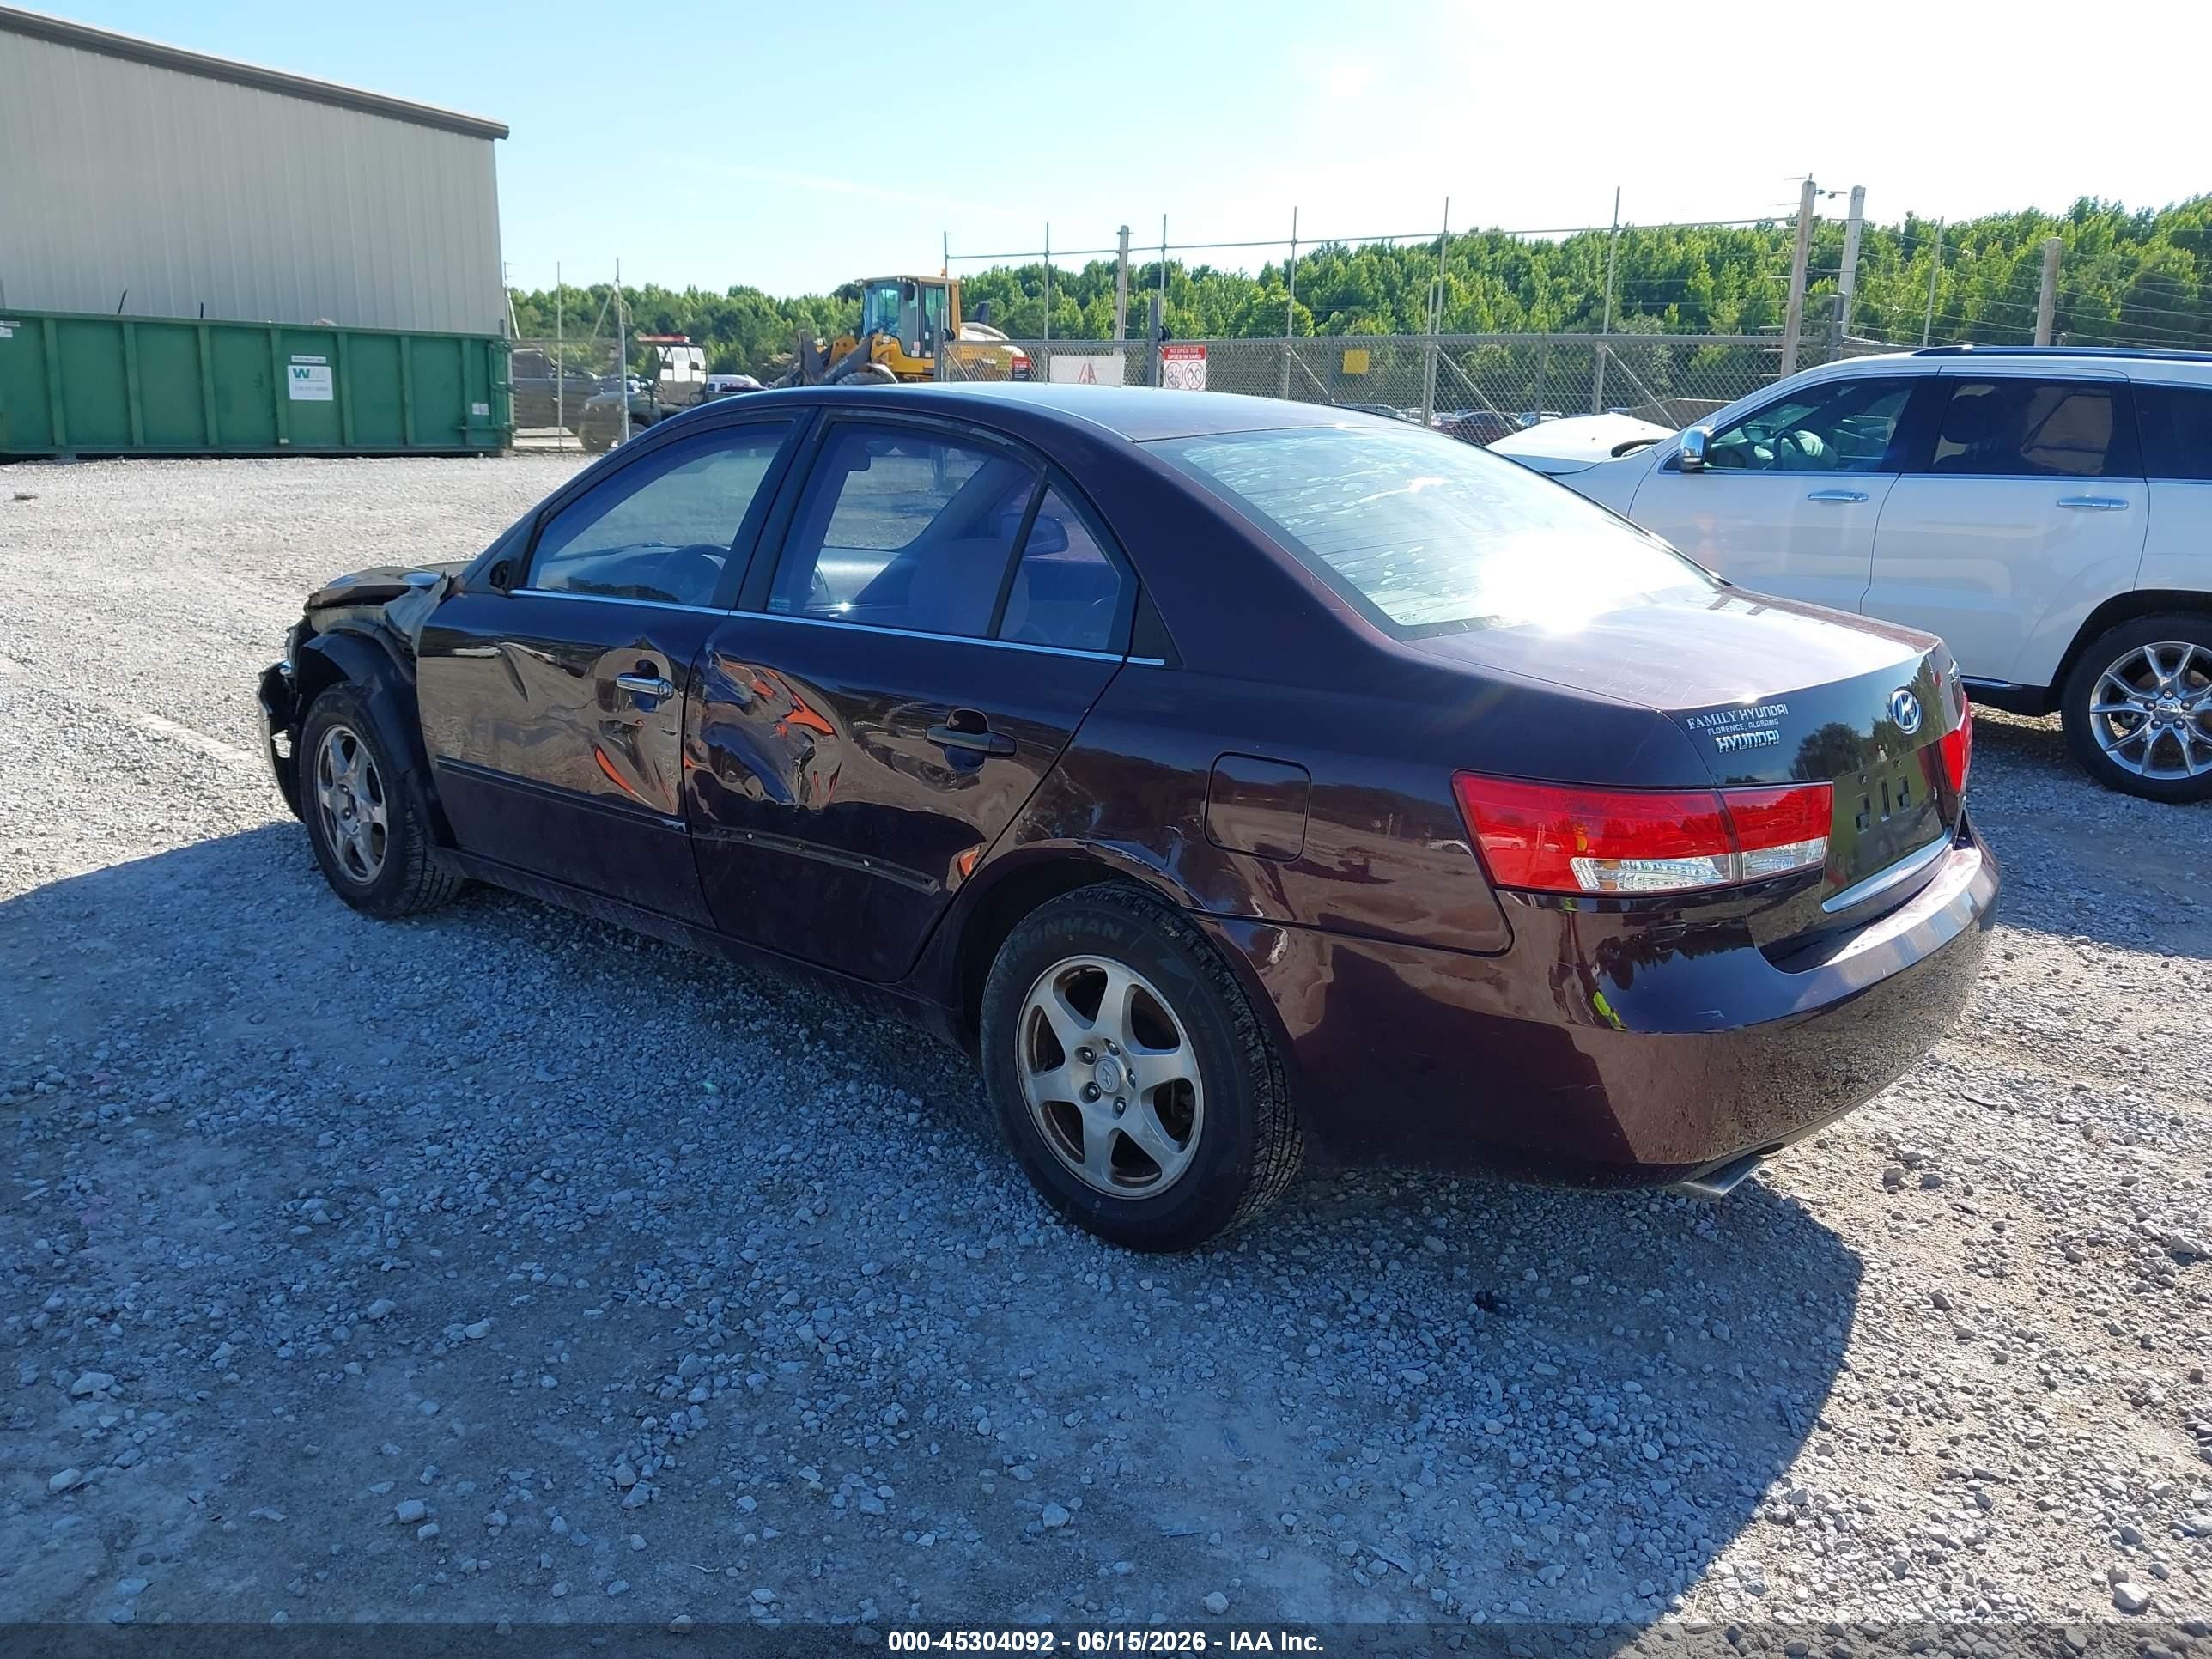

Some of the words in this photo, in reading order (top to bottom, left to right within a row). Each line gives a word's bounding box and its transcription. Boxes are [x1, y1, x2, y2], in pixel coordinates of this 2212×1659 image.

[1686, 711, 1736, 730] FAMILY
[1739, 704, 1788, 720] HYUNDAI
[1707, 724, 1747, 736] FLORENCE,
[1748, 719, 1779, 729] ALABAMA
[1716, 730, 1780, 753] HYUNDAI
